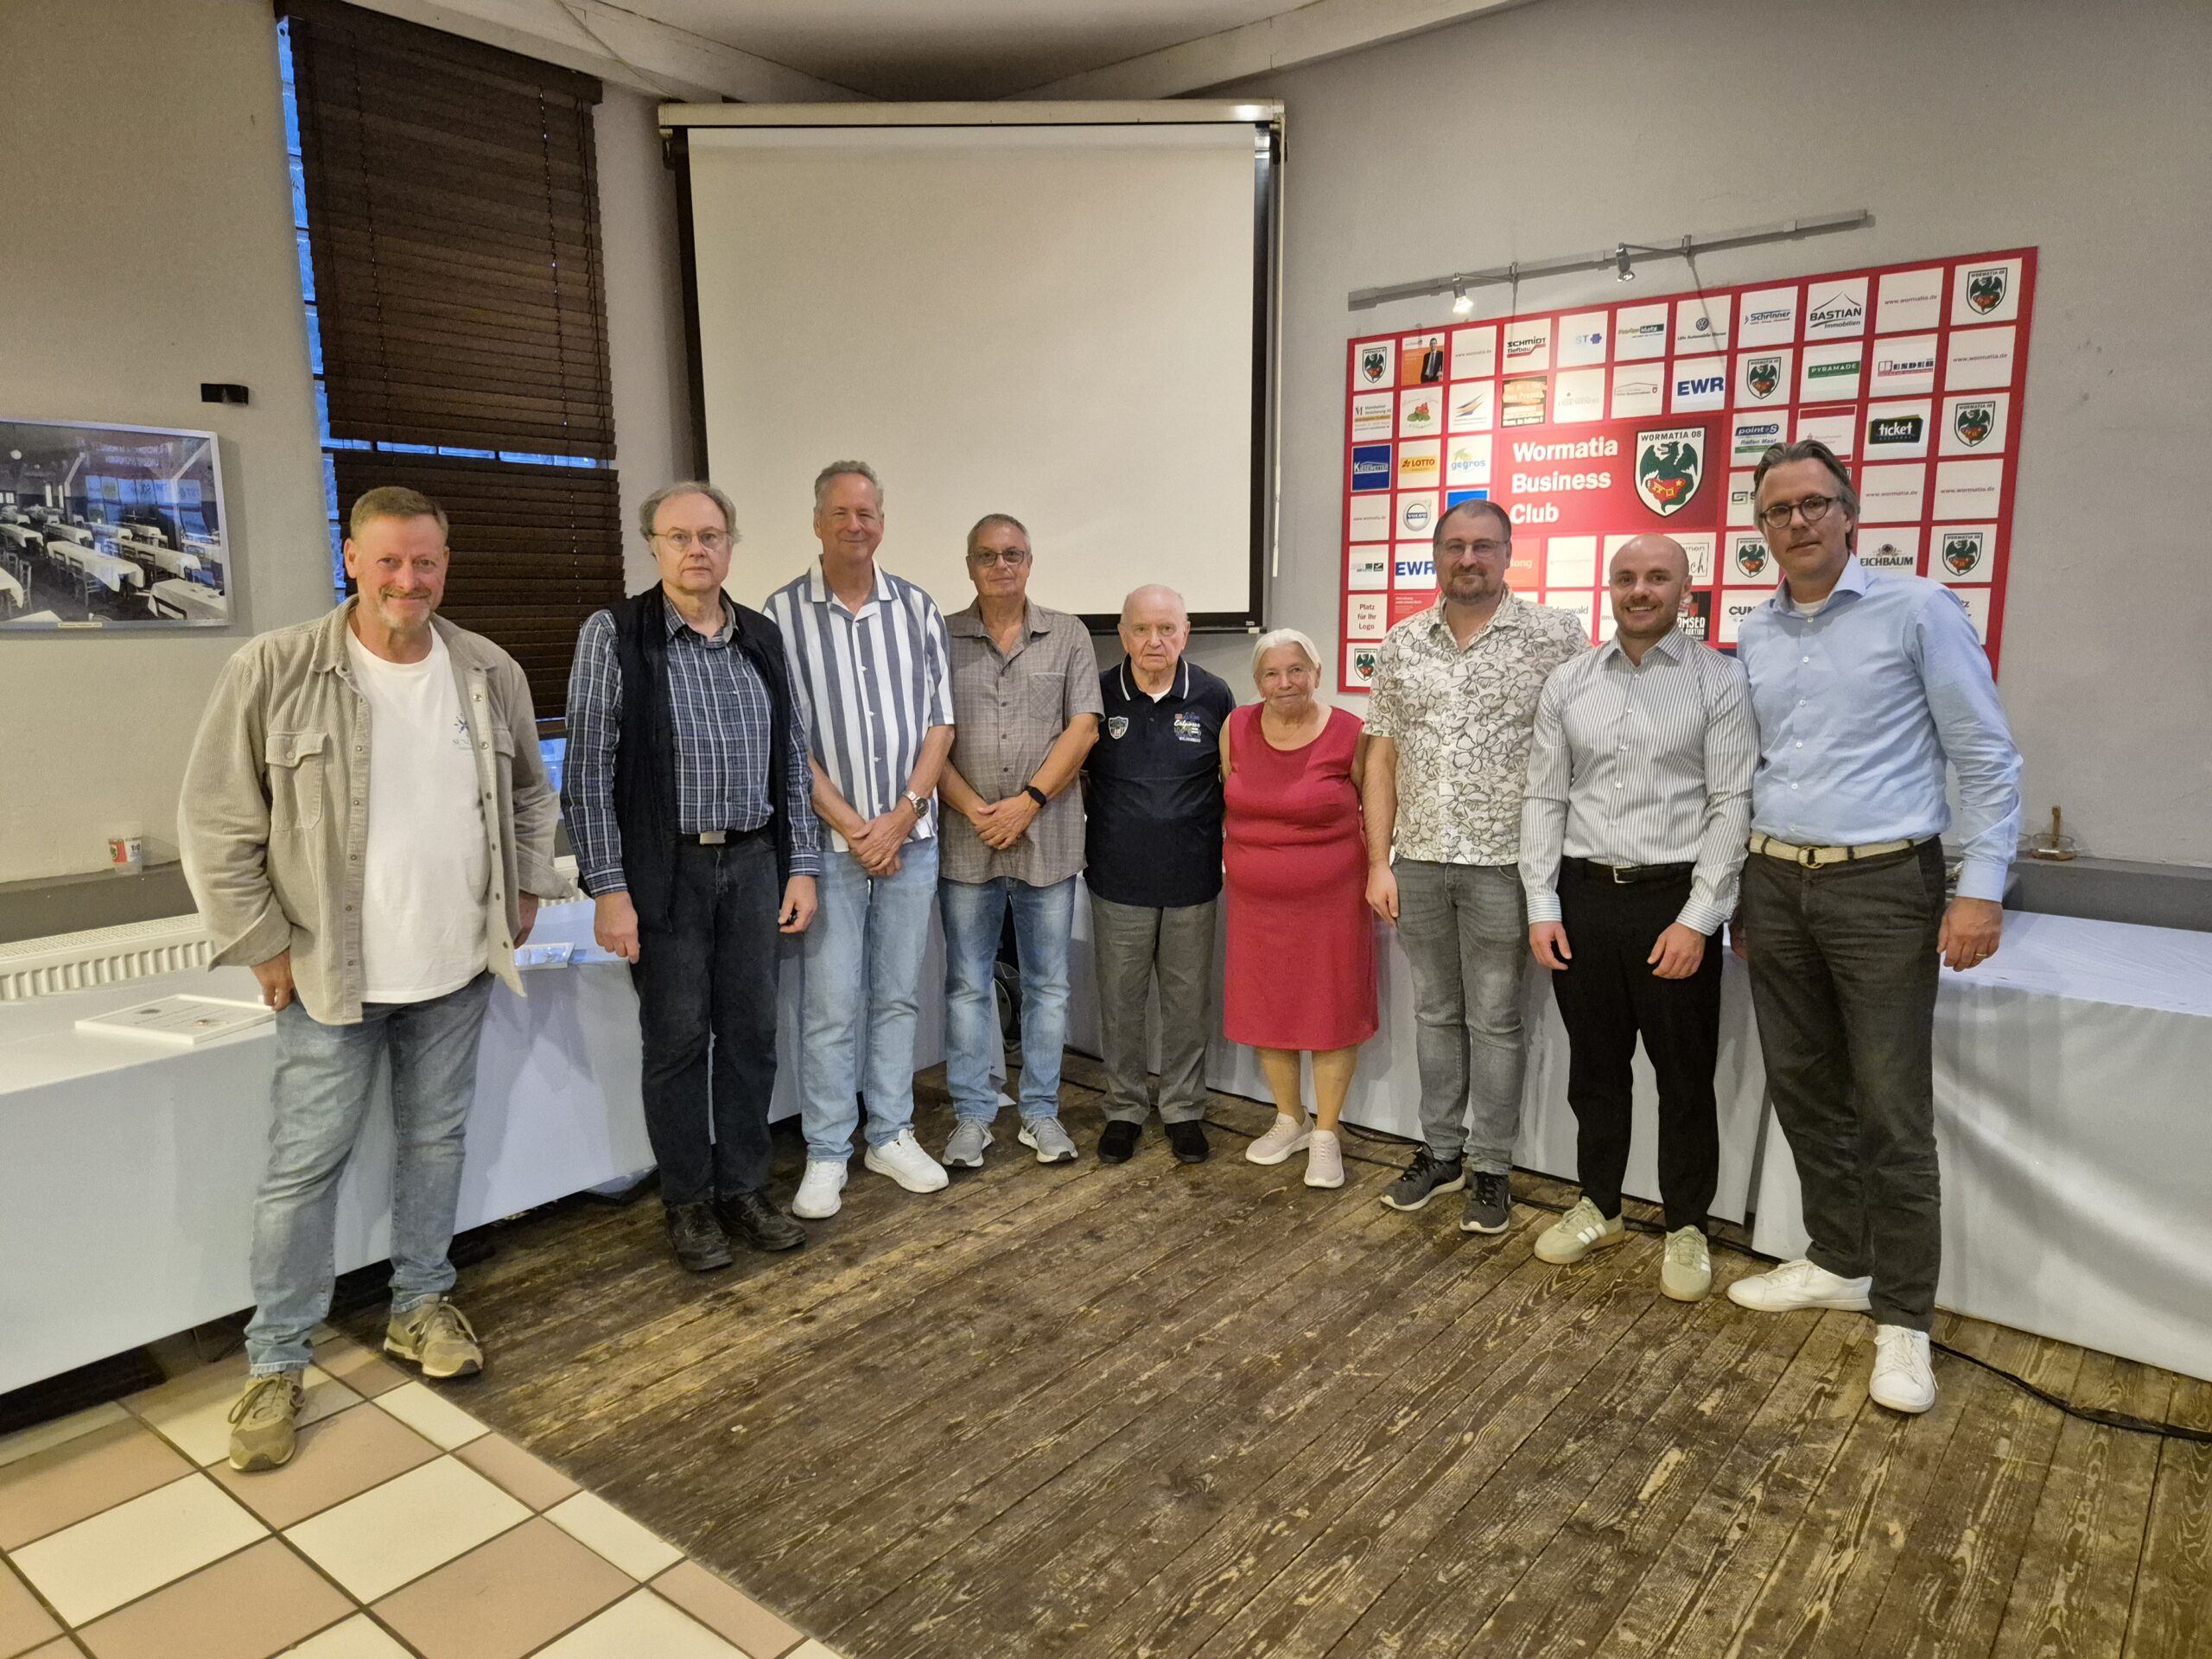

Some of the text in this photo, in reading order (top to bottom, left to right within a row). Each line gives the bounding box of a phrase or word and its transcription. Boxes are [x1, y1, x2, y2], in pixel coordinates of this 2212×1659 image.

[1885, 295, 1937, 305] www.wormatia.de
[1809, 308, 1862, 321] BASTIAN
[1824, 321, 1860, 329] Immobilien
[1953, 353, 2008, 362] www.wormatia.de
[1677, 377, 1725, 397] EWR
[1878, 422, 1913, 436] ticket
[1640, 431, 1689, 442] WORMATIA
[1512, 435, 1618, 462] Wormatia
[1412, 459, 1435, 467] LOTTO
[1452, 460, 1486, 471] gegros
[1511, 470, 1611, 493] Business
[1510, 501, 1560, 524] Club
[1510, 558, 1533, 569] long
[1860, 556, 1913, 567] EICHBAUM
[1395, 561, 1436, 575] EWR
[1729, 606, 1756, 615] CUN
